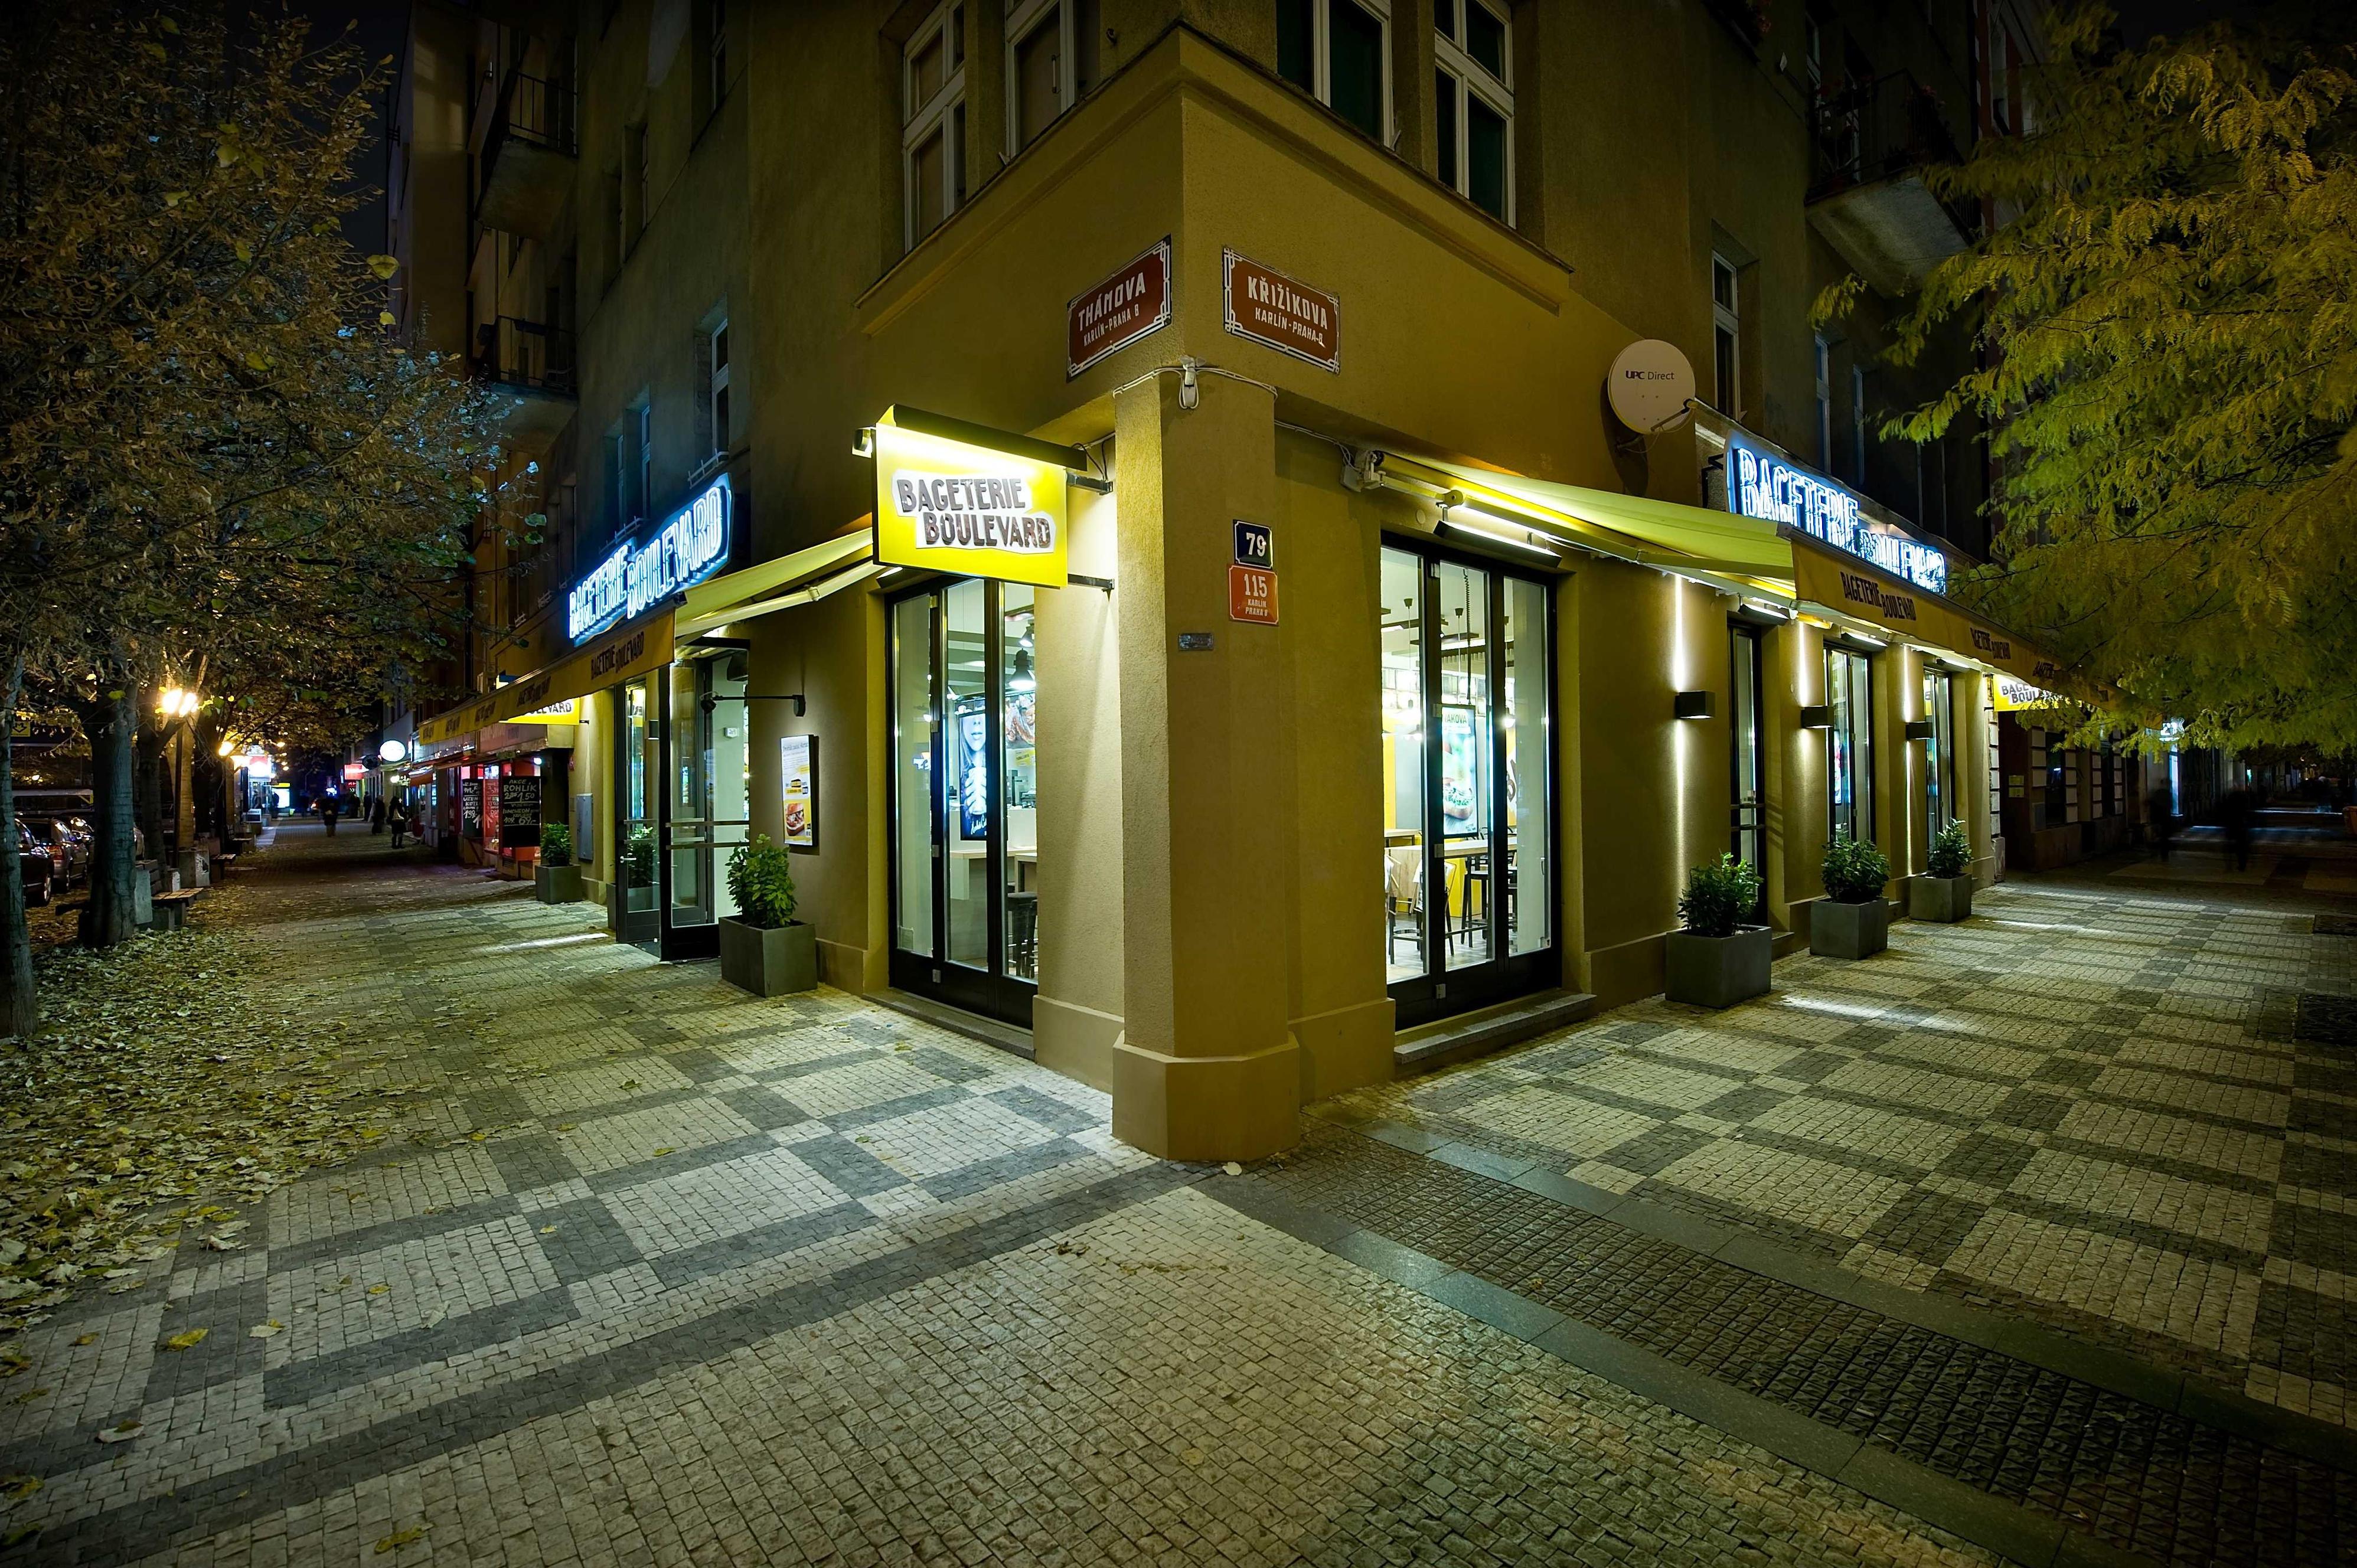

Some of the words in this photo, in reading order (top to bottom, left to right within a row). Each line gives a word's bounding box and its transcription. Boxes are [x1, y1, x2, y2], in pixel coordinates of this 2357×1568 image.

[1078, 272, 1145, 331] THÁMOVA
[1134, 303, 1139, 316] 8
[1625, 370, 1645, 380] UPC
[1647, 371, 1675, 380] Direct
[897, 478, 1026, 512] BAGETERIE
[923, 512, 1051, 548] BOULEVARD
[1246, 532, 1267, 557] 79
[569, 544, 628, 639] BAGETERIE
[627, 486, 723, 619] BOULEVARD
[1244, 573, 1268, 598] 115
[1840, 571, 1882, 608] BAGETERIE
[1881, 593, 1917, 621] BOULEVARD
[1245, 606, 1264, 616] PRAHA
[504, 782, 537, 792] ROHLÍK
